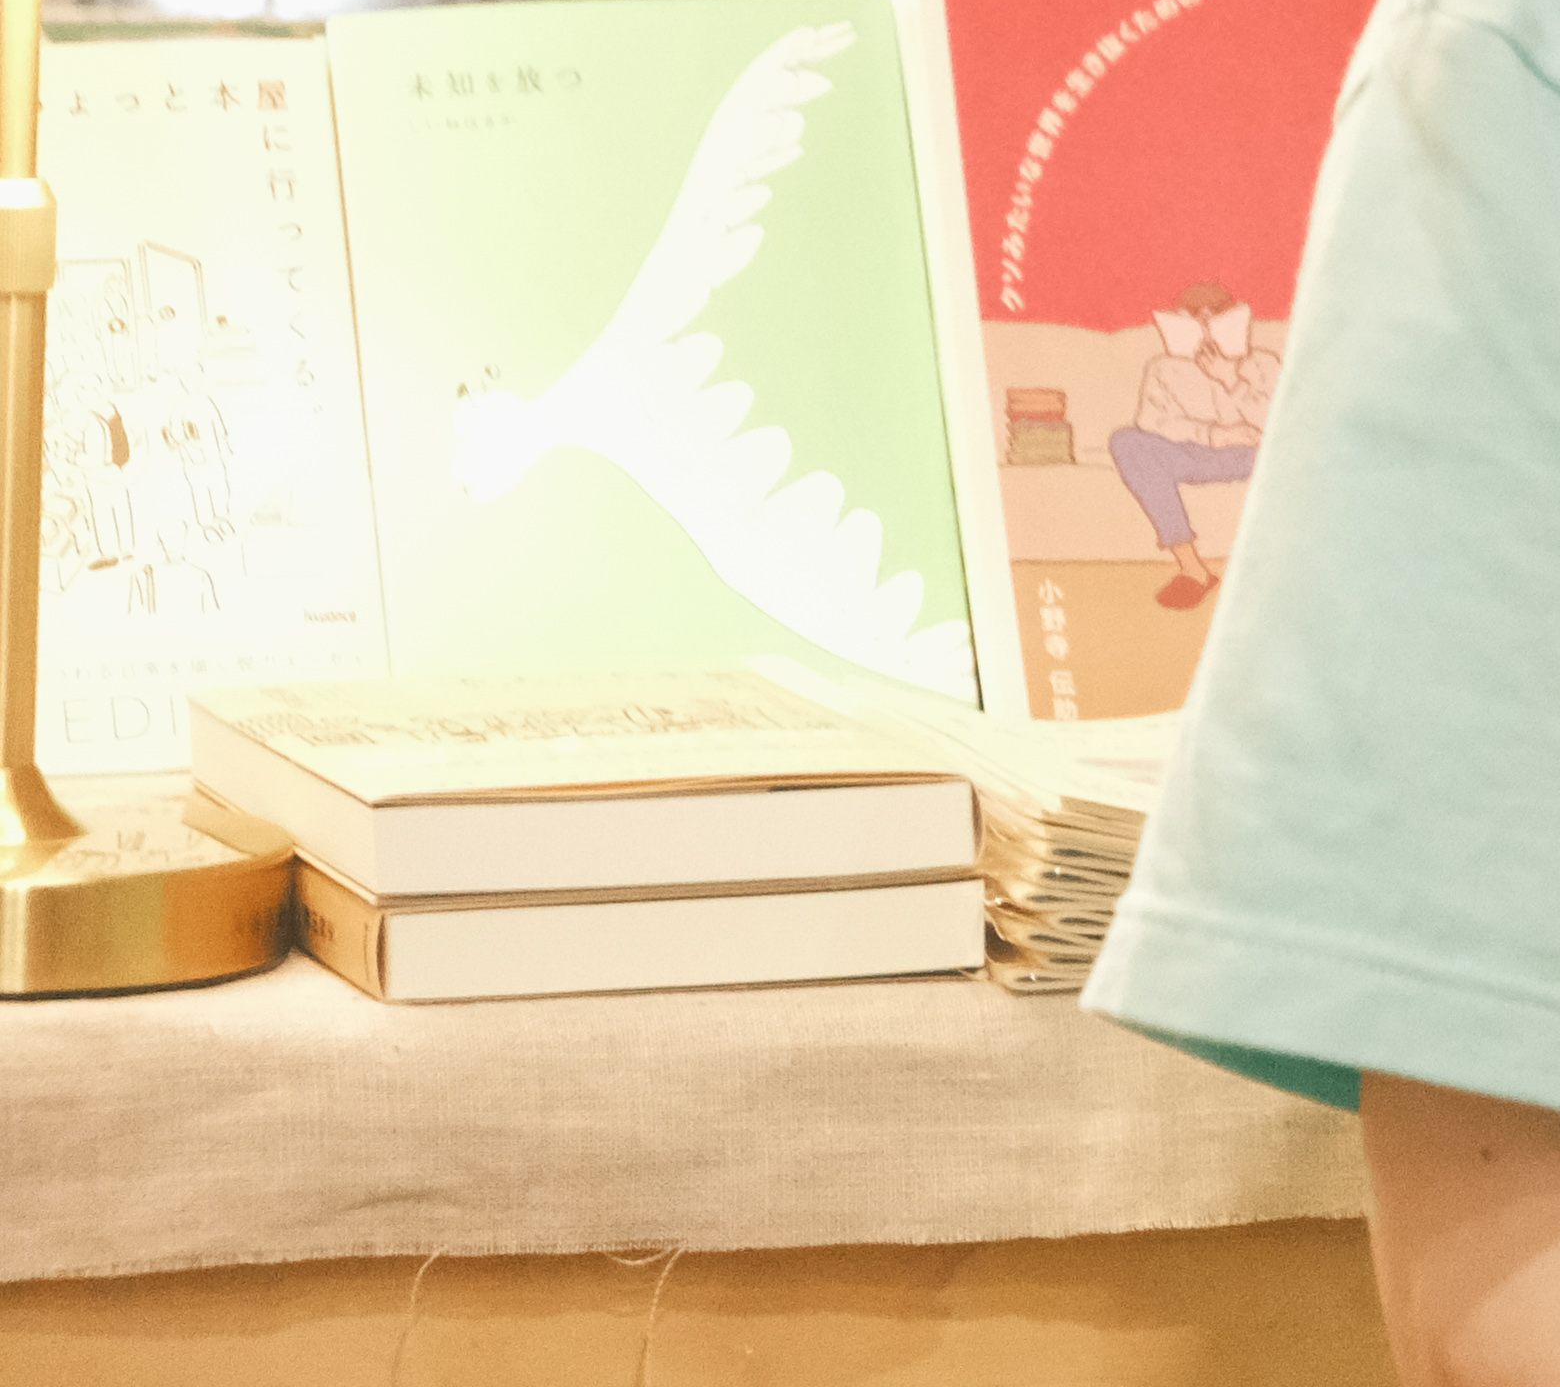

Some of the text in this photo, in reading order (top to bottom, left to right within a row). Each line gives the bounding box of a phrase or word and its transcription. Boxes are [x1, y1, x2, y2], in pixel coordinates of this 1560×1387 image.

[408, 64, 584, 104] 未知を放つ
